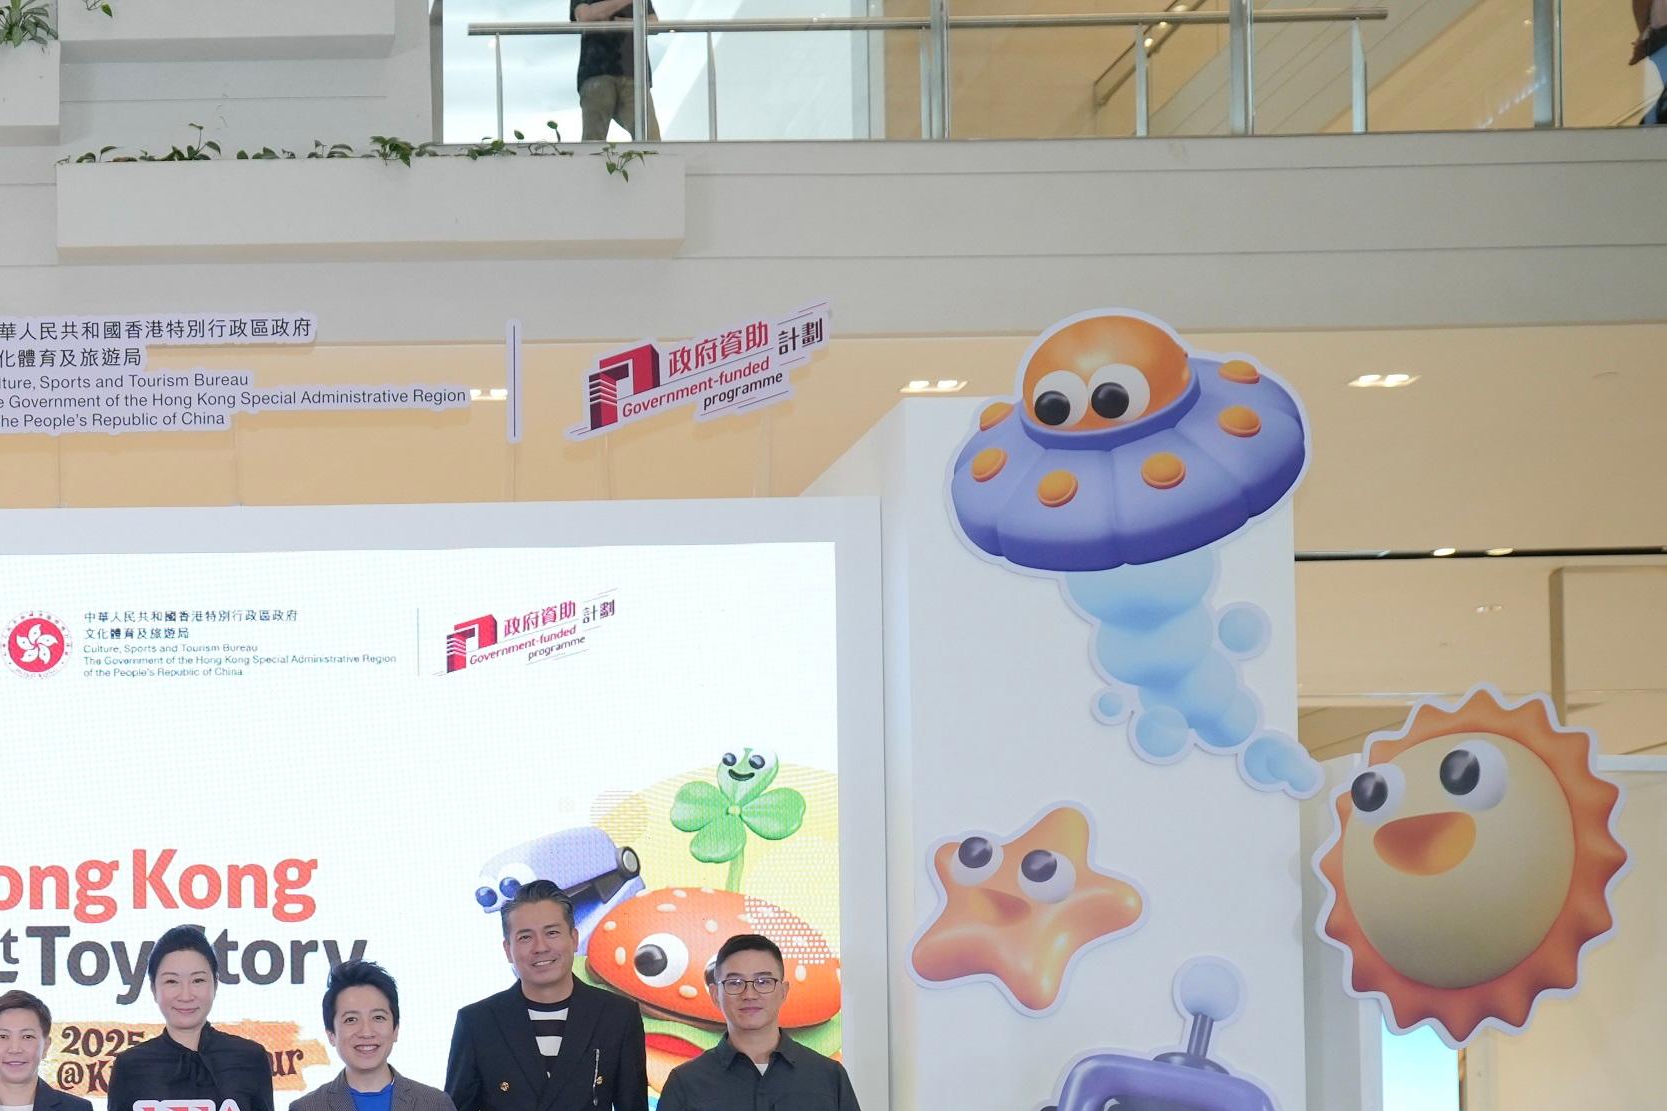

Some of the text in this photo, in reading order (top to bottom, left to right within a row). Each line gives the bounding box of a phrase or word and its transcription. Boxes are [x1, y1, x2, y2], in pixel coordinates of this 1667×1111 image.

[669, 318, 823, 377] 政府資助 計劃
[40, 375, 91, 391] Sports
[95, 375, 123, 388] and
[129, 374, 189, 387] Tourism
[195, 373, 248, 387] Bureau
[623, 356, 770, 417] Government-funded
[704, 372, 783, 410] programme
[9, 394, 101, 409] Government
[106, 394, 120, 407] of
[125, 393, 148, 406] the
[153, 393, 192, 408] Hong
[198, 392, 236, 408] Kong
[241, 391, 296, 406] Special
[301, 389, 408, 404] Administrative
[413, 389, 466, 405] Region
[24, 414, 87, 430] People's
[92, 413, 157, 428] Republic
[162, 412, 177, 425] of
[181, 412, 225, 425] China
[84, 610, 298, 623] 中華人民共和國香港特別行政區政府
[504, 599, 615, 637] 政府資助 計劃
[85, 628, 189, 640] 文化體育及旅遊局
[470, 625, 577, 665] Government-funded
[83, 643, 258, 654] Culture, Sports and Tourism Bureau
[528, 637, 586, 661] programme
[83, 654, 397, 666] The Government of the Hong Kong Special Administrative Region
[84, 668, 243, 678] of the People's Republic of China
[133, 848, 318, 922] Kong
[26, 925, 154, 1005] Toy
